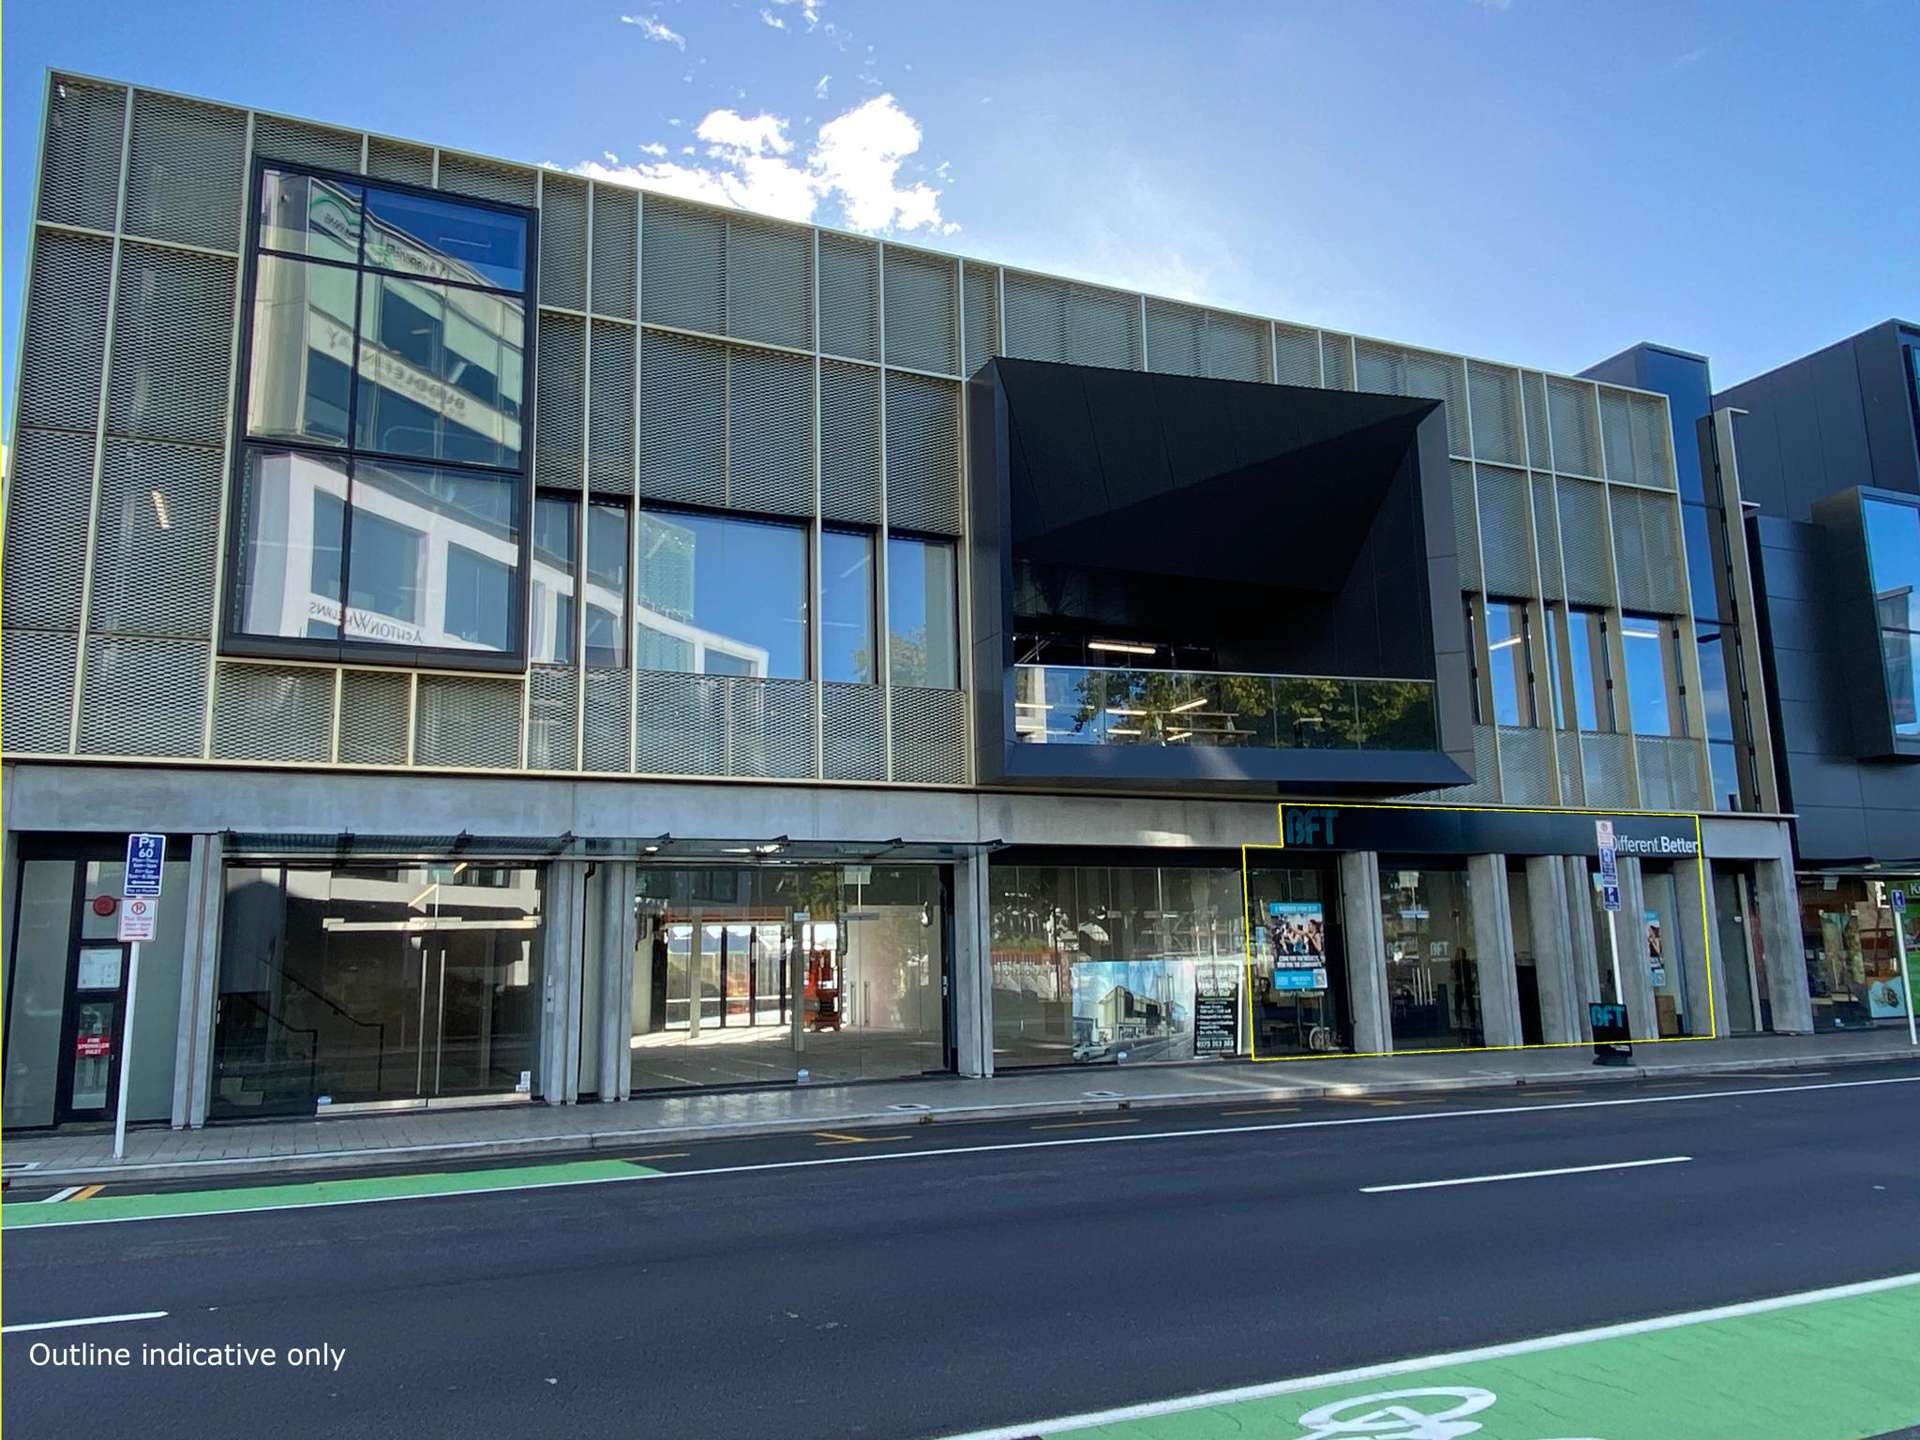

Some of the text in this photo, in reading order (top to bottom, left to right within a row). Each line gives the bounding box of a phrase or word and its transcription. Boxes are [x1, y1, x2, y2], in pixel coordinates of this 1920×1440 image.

[1286, 809, 1338, 846] BFT
[138, 848, 154, 858] 60
[1591, 1005, 1625, 1028] BFT
